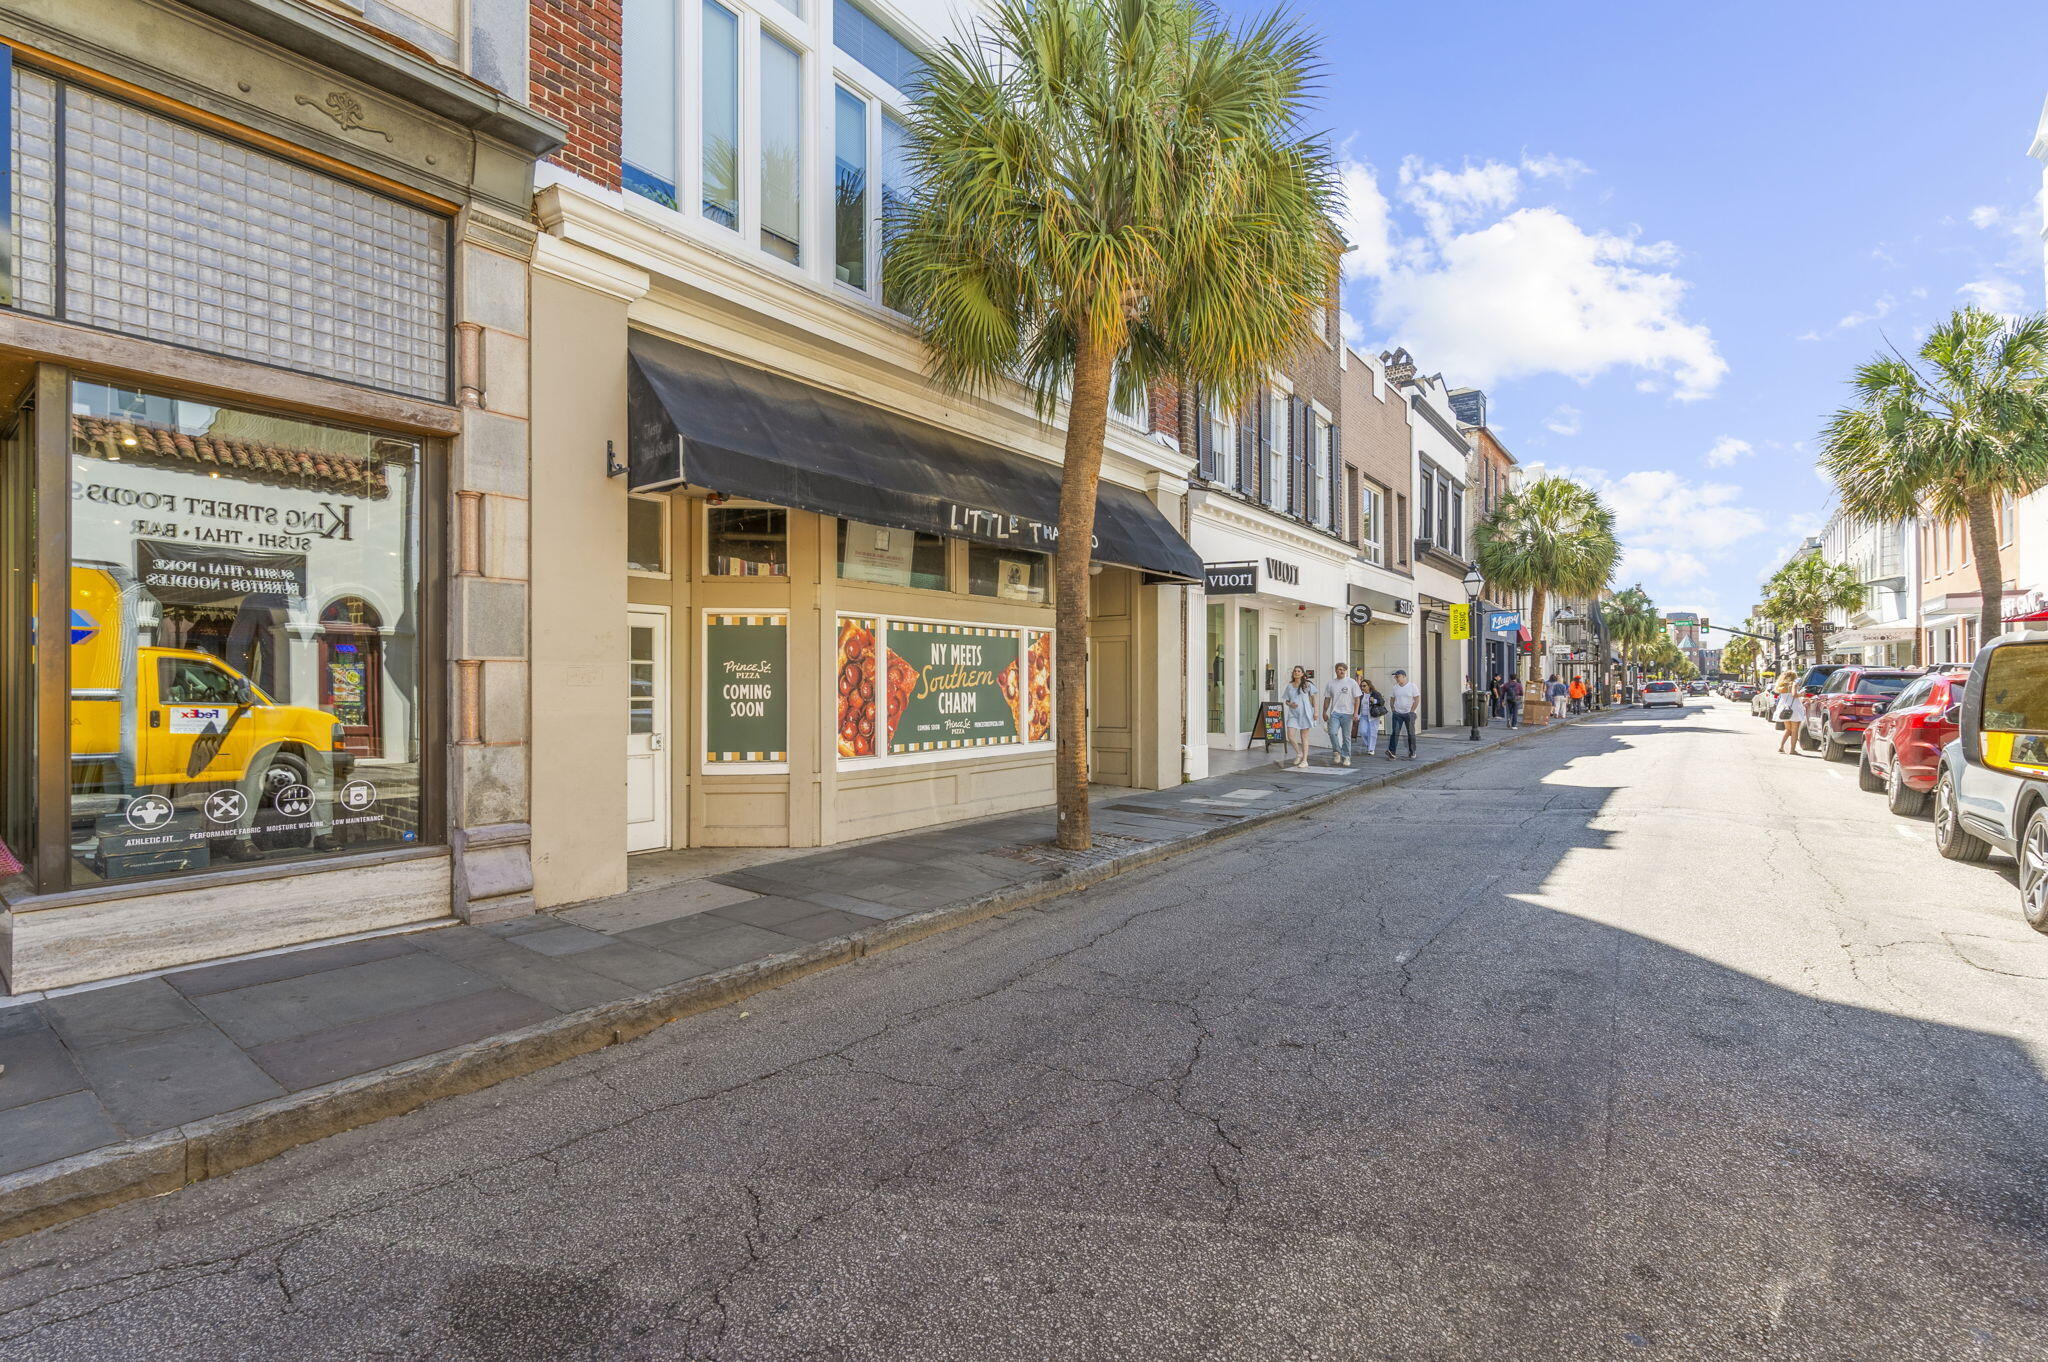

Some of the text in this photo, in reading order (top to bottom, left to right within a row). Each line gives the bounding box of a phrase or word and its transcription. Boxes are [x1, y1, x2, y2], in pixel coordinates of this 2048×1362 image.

[951, 504, 1019, 539] LITTLE
[1029, 522, 1059, 543] THA
[1208, 573, 1253, 587] vuori
[1353, 605, 1368, 624] S
[931, 643, 982, 666] NY MEETS
[723, 660, 758, 673] Prince
[916, 664, 995, 699] Southern
[723, 684, 772, 700] COMING
[730, 701, 764, 717] SOON
[938, 692, 977, 714] CHARM
[266, 820, 324, 833] MOISTURE WICKING
[332, 814, 385, 826] LOW MAINTENANCE
[189, 825, 262, 840] PERFORMANCE FABRIC
[125, 835, 161, 847] ATHLETIC
[162, 835, 174, 844] FIT
